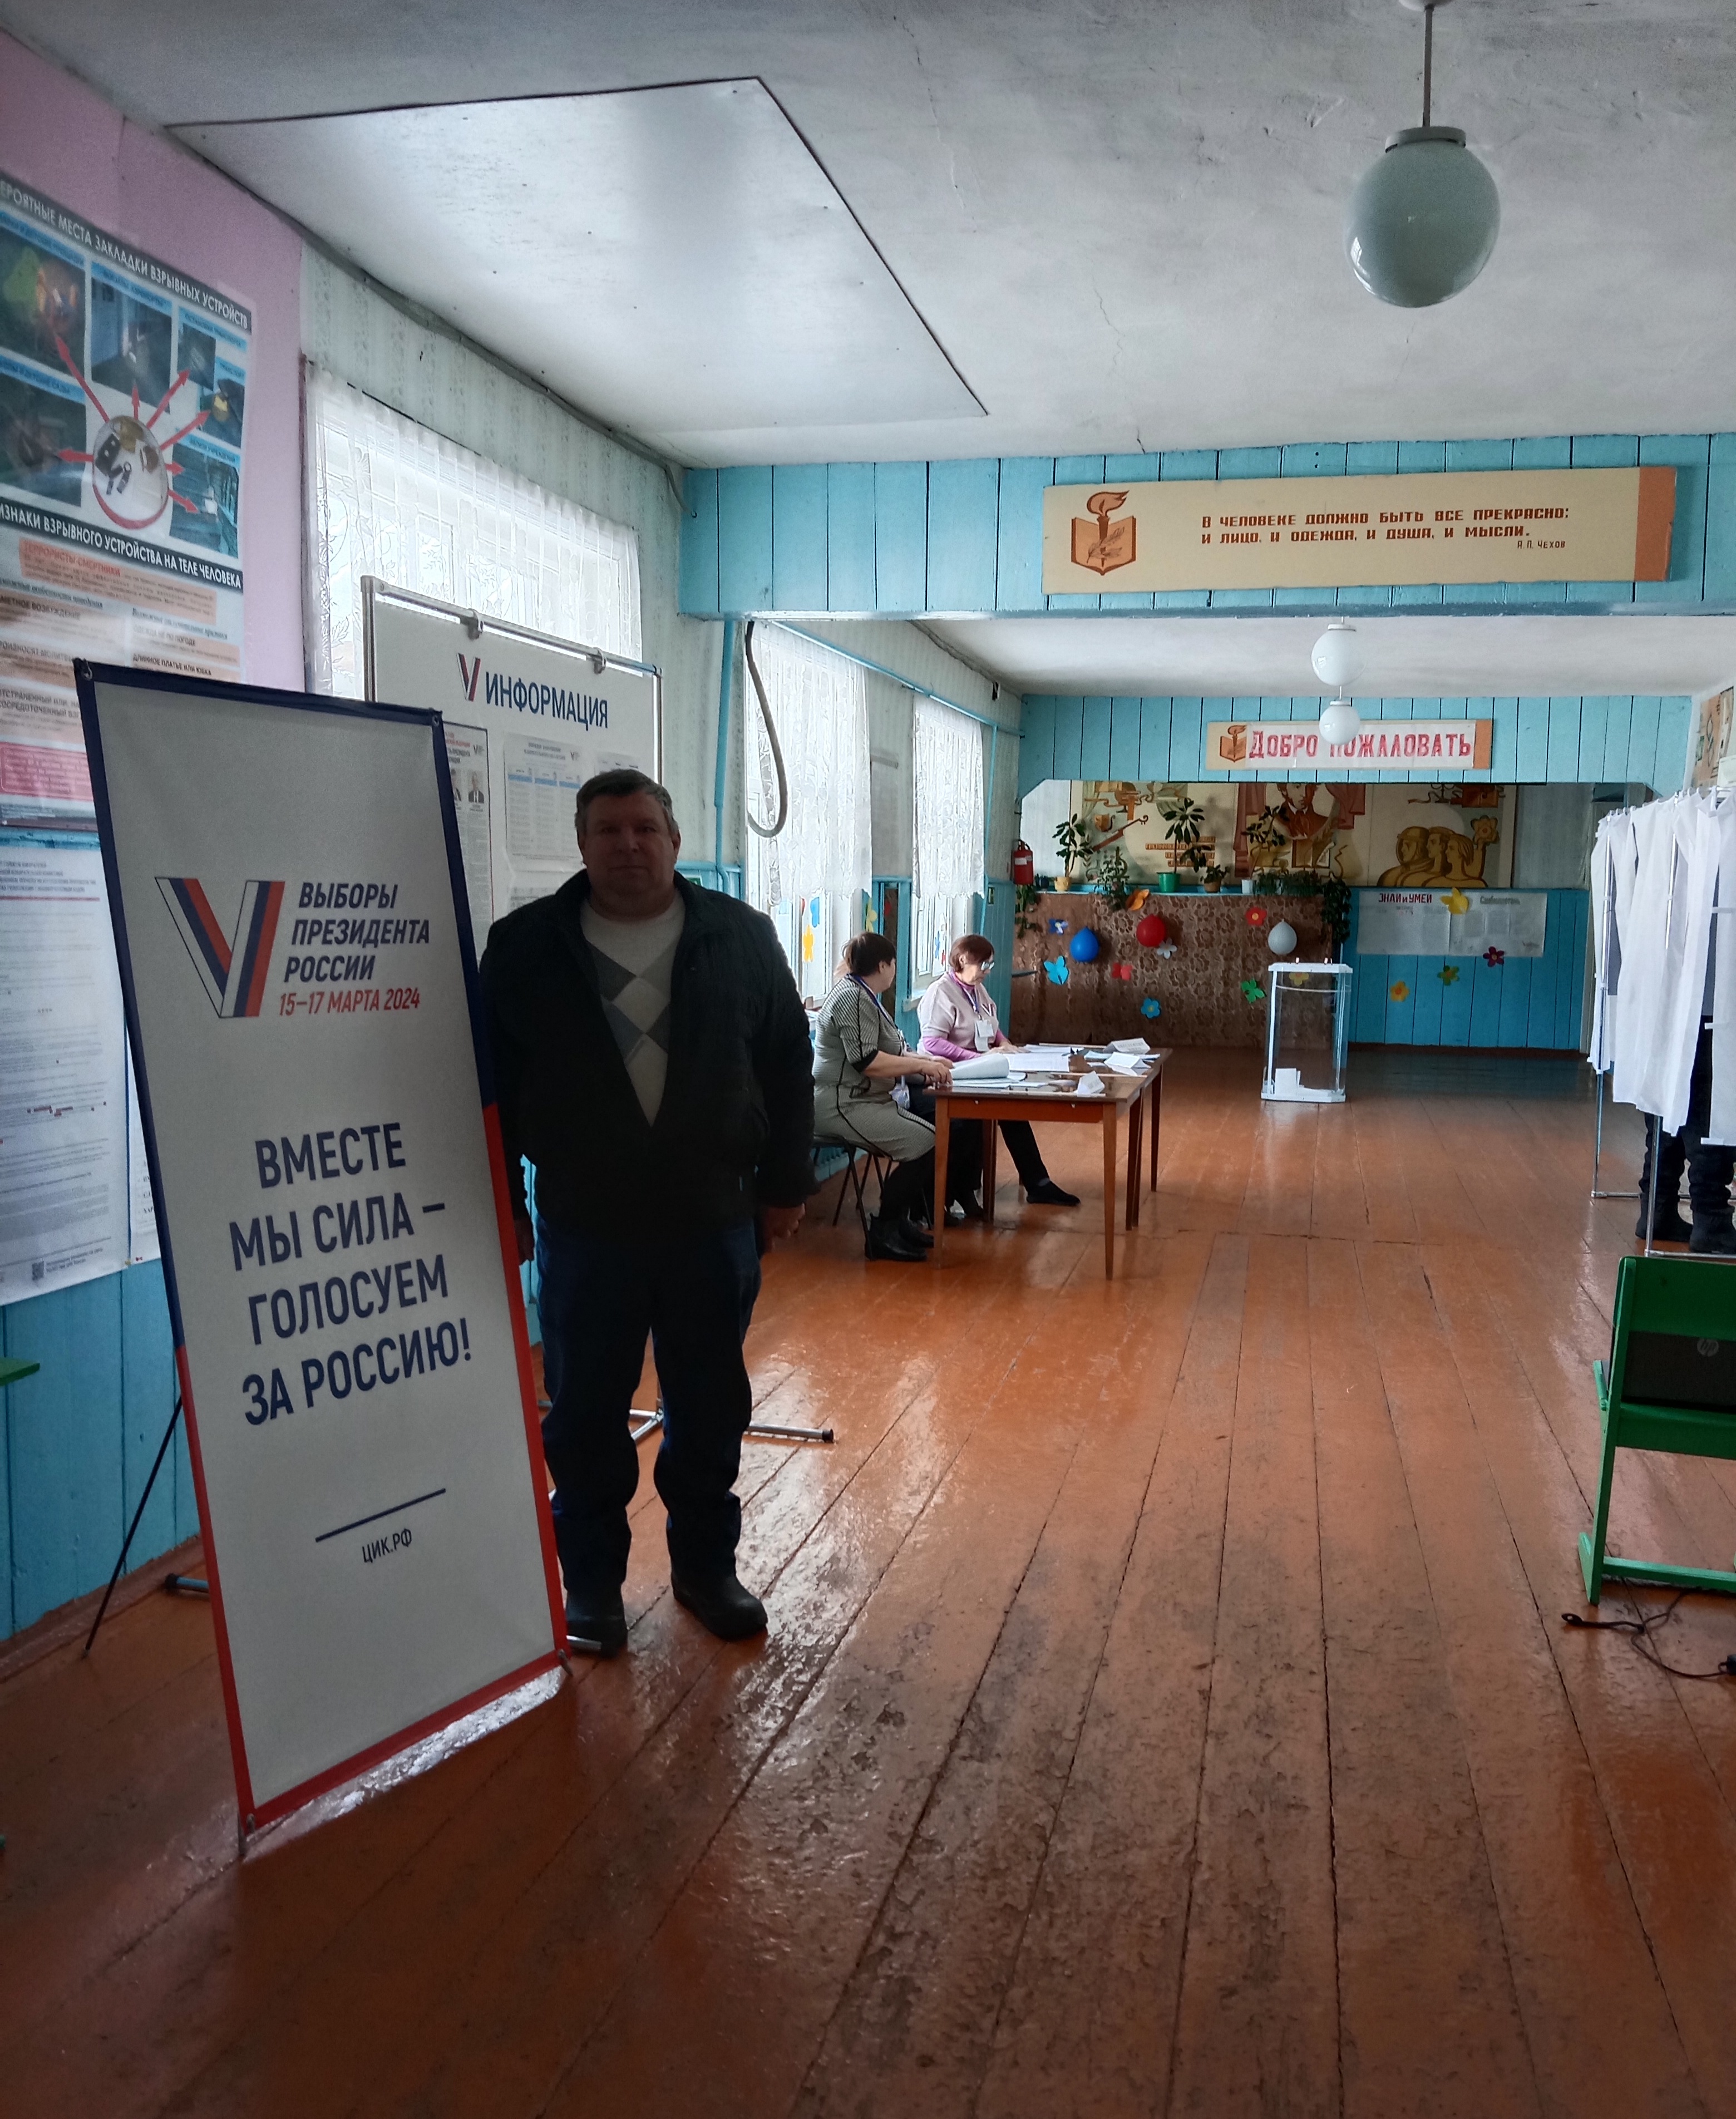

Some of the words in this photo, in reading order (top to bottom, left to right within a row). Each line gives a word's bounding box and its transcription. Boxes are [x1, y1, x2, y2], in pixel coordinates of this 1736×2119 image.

[58, 214, 92, 247] МЕСТА
[96, 234, 147, 275] ЗАКЛАДКИ
[151, 264, 200, 303] ВЗРЫВНЫХ
[203, 292, 248, 329] УСТРОЙСТВ
[1202, 516, 1211, 528] В
[1220, 515, 1296, 527] ЧЕЛОВЕКЕ
[1305, 513, 1369, 525] ДОЛЖНО
[1379, 511, 1424, 523] БЫТЬ
[1434, 510, 1464, 522] ВСЕ
[1473, 507, 1569, 520] ПРЕКРАСНО:
[1202, 534, 1211, 544] И
[1270, 531, 1280, 543] И
[1291, 530, 1358, 542] ОДЕЖДА,
[1367, 529, 1376, 540] И
[1386, 528, 1434, 540] ДУША,
[1444, 527, 1454, 538] И
[1465, 525, 1530, 538] МЫСЛИ.
[1537, 540, 1566, 549] ЧЕХОВ
[44, 516, 102, 548] ВЗРЫВНОГО
[105, 535, 162, 566] УСТРОЙСТВА
[165, 554, 177, 570] НА
[179, 557, 198, 576] ТЕЛЕ
[199, 564, 241, 589] ЧЕЛОВЕКА
[486, 672, 609, 732] ИНФОРМАЦИЯ
[1249, 730, 1318, 759] ДОБРО
[1329, 733, 1471, 758] ПОЖАЛОВАТЬ
[299, 881, 398, 909] ВЫБОРЫ
[292, 919, 430, 948] ПРЕЗИДЕНТА
[284, 955, 376, 983] РОССИИ
[327, 990, 379, 1014] МАРТА
[384, 988, 420, 1011] 2024
[255, 1122, 406, 1189] ВМЕСТЕ
[229, 1211, 302, 1272] МЫ
[313, 1192, 414, 1254] СИЛА
[249, 1254, 448, 1346] ГОЛОСУЕМ
[243, 1368, 294, 1426] ЗА
[301, 1317, 471, 1408] РОССИЮ!
[362, 1528, 412, 1563] ЦИК.РФ
